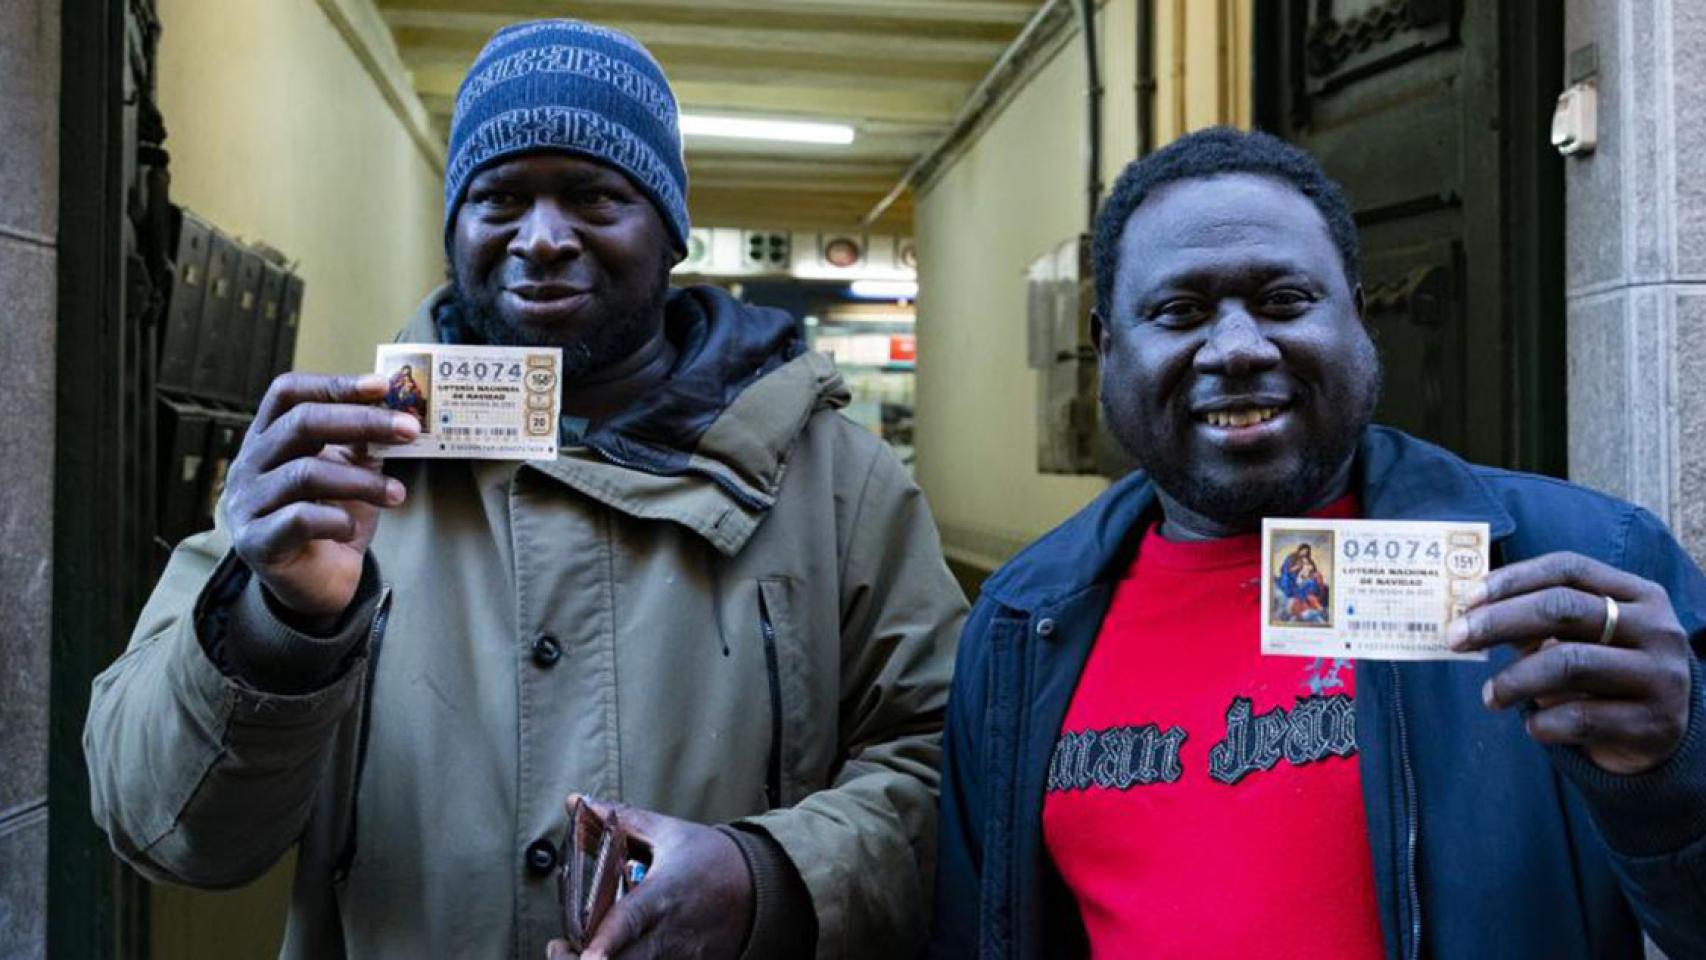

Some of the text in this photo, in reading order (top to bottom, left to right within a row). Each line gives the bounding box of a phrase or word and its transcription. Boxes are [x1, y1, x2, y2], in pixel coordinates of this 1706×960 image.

[439, 361, 521, 379] 04074
[477, 385, 520, 393] NACIONAL
[466, 393, 506, 401] NAVIDAD
[533, 417, 546, 427] 20
[1343, 539, 1441, 559] 04074
[1388, 568, 1439, 577] NACIONAL
